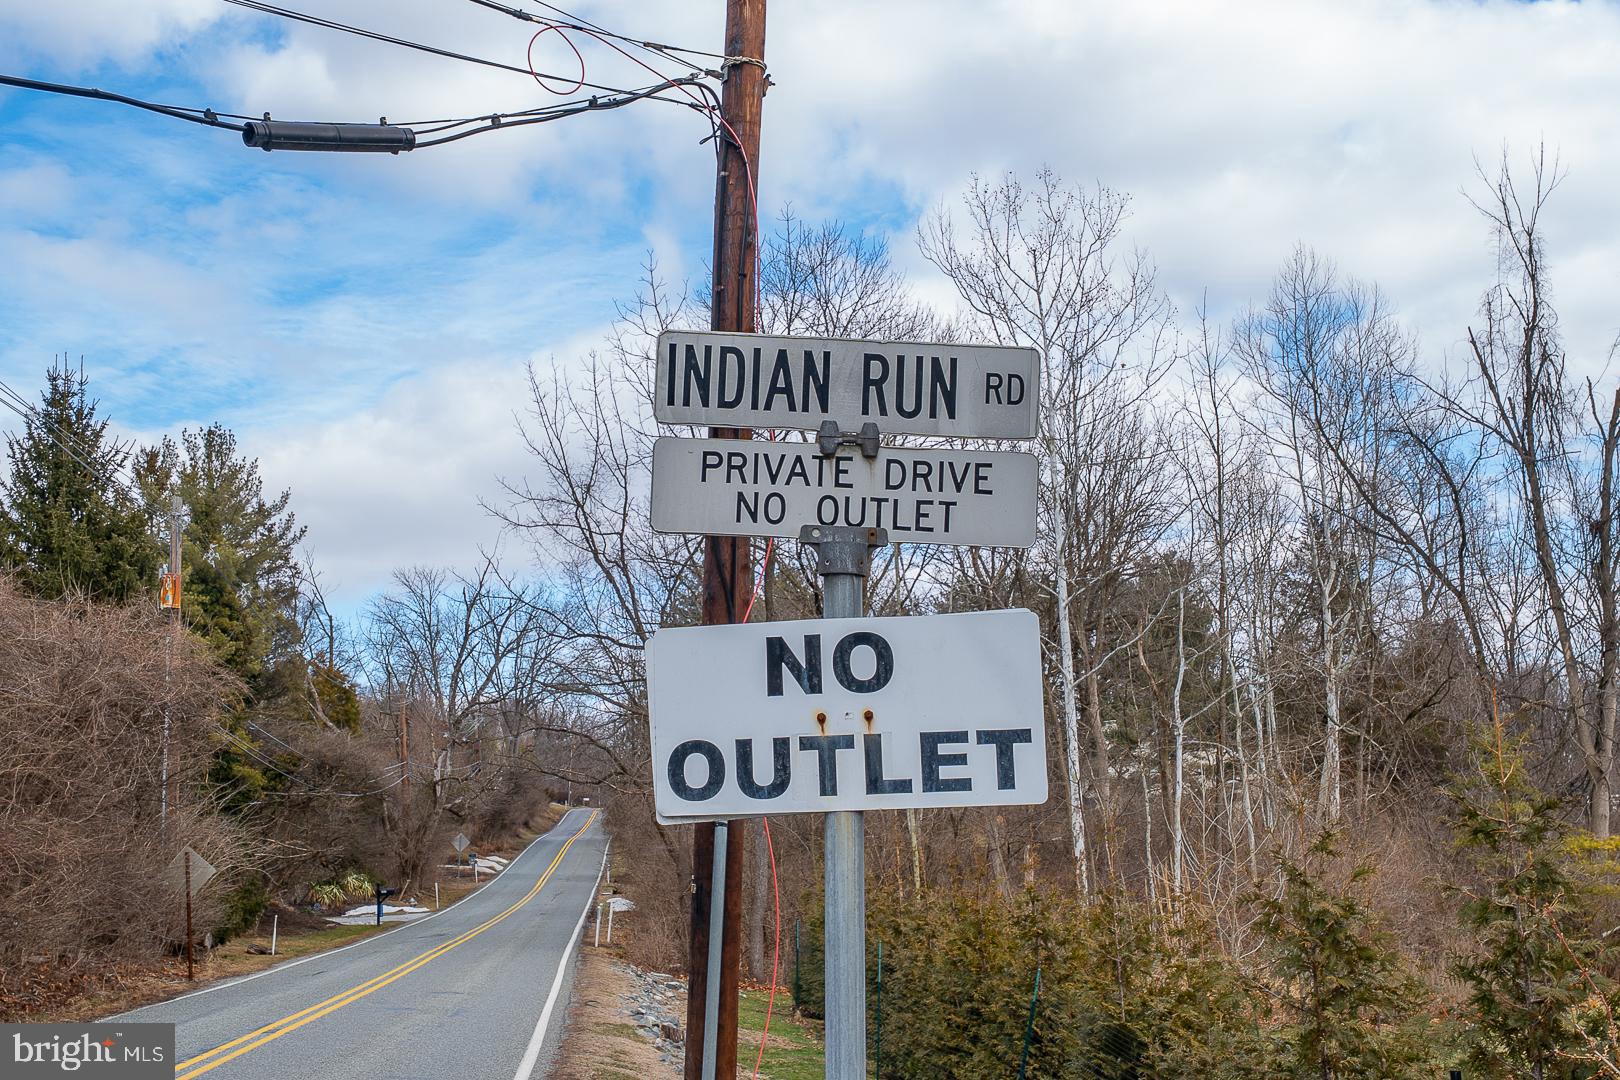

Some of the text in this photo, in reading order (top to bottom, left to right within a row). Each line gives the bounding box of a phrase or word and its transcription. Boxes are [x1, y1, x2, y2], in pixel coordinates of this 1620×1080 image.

[666, 343, 1025, 420] INDIAN RUN RD
[701, 451, 994, 495] PRIVATE DRIVE
[735, 491, 958, 533] NO OUTLET
[765, 631, 895, 697] NO
[667, 728, 1033, 802] OUTLET
